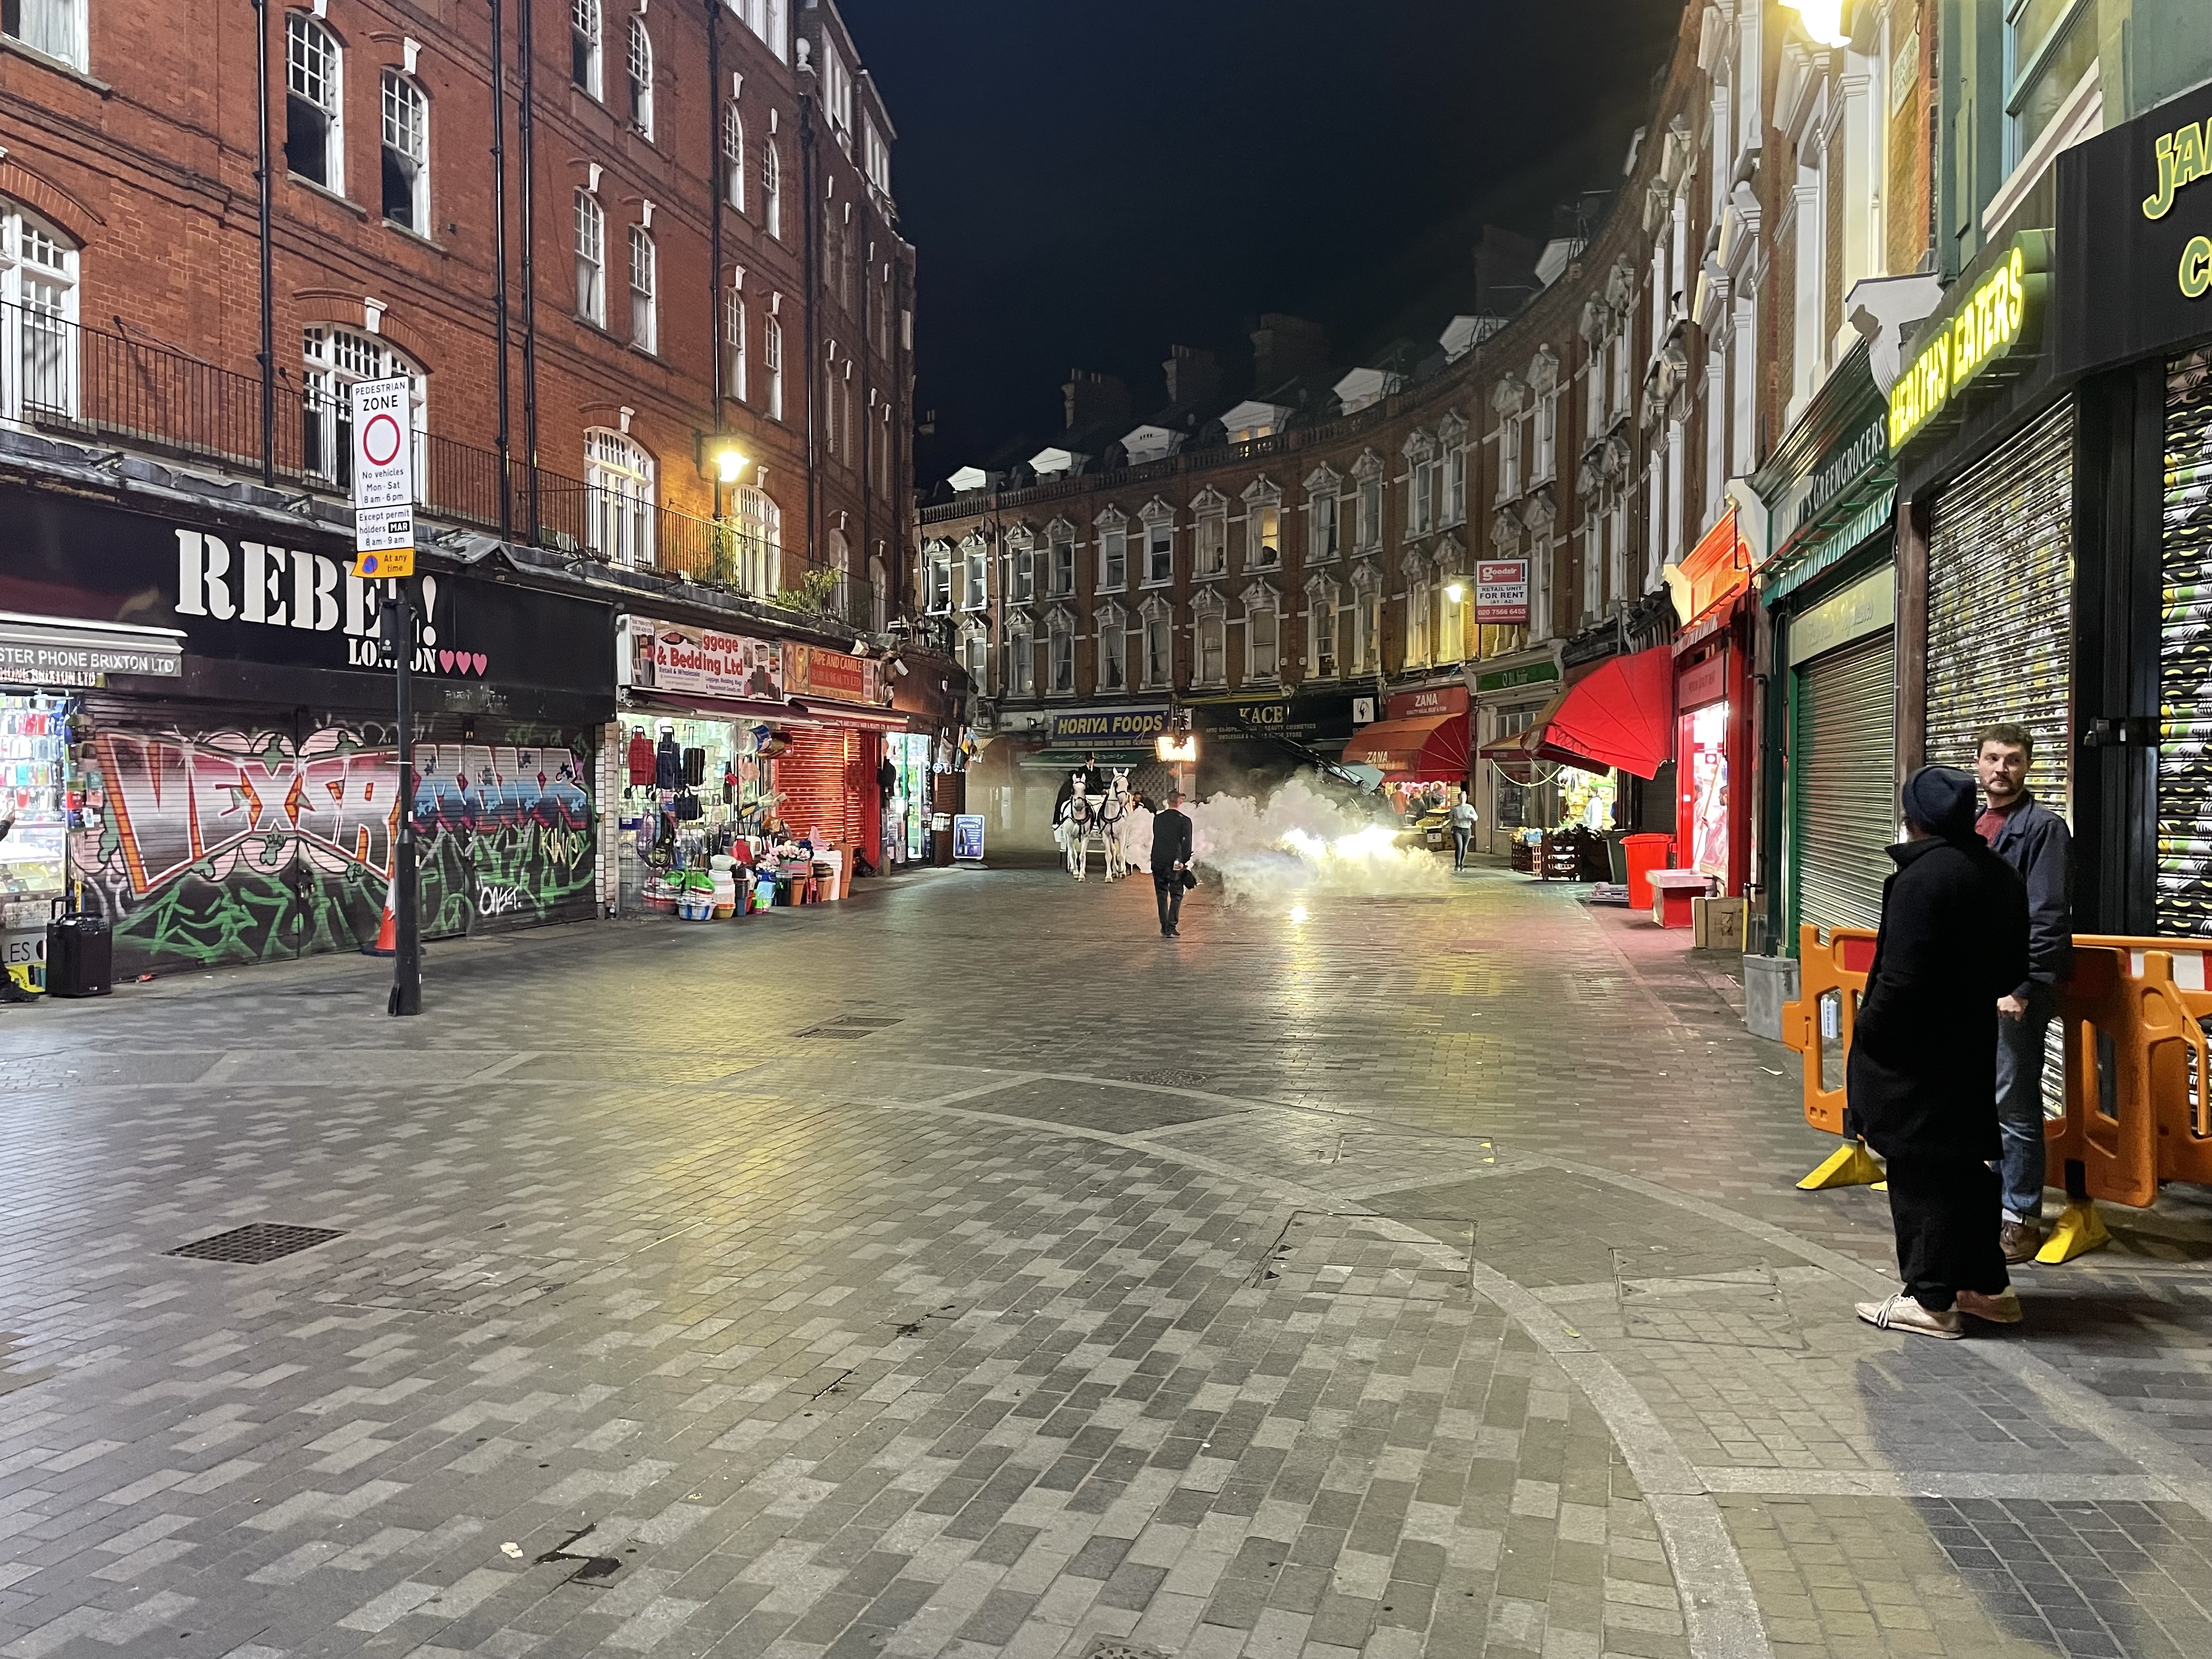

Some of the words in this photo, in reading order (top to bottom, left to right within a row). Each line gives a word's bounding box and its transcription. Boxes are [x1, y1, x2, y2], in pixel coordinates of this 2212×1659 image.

[2142, 116, 2212, 219] jA
[2179, 236, 2212, 297] C
[1890, 331, 1950, 448] HEALTHY
[1953, 247, 2023, 385] EATERS
[355, 381, 405, 396] PEDESTRIAN
[363, 395, 398, 411] ZONE
[1813, 413, 1885, 511] GREENGROCERS
[362, 471, 373, 479] No
[375, 468, 404, 478] vehicles
[366, 483, 382, 492] Mon
[387, 481, 400, 489] Sat
[393, 494, 404, 503] pm
[359, 512, 384, 521] Except
[386, 509, 410, 520] permit
[359, 526, 386, 534] holders
[390, 522, 408, 532] MAR
[394, 554, 408, 562] any
[1482, 567, 1517, 581] goodsir
[174, 528, 437, 646] REBE!
[38, 650, 87, 667] PHONE
[91, 653, 148, 671] BRIXTON
[151, 657, 174, 673] LTD
[348, 638, 437, 673] LOON
[657, 645, 667, 665] &
[670, 647, 721, 676] Bedding
[724, 656, 743, 676] Ltd
[810, 651, 826, 667] PAPE
[826, 654, 840, 668] AND
[840, 657, 862, 673] CAMILE
[678, 668, 701, 678] Wholesale
[850, 675, 861, 687] LTD
[1415, 693, 1438, 707] ZANA
[1239, 706, 1284, 724] KACE
[1058, 717, 1108, 734] HORIYA
[1112, 714, 1163, 733] FOODS
[1365, 751, 1388, 763] ZANA
